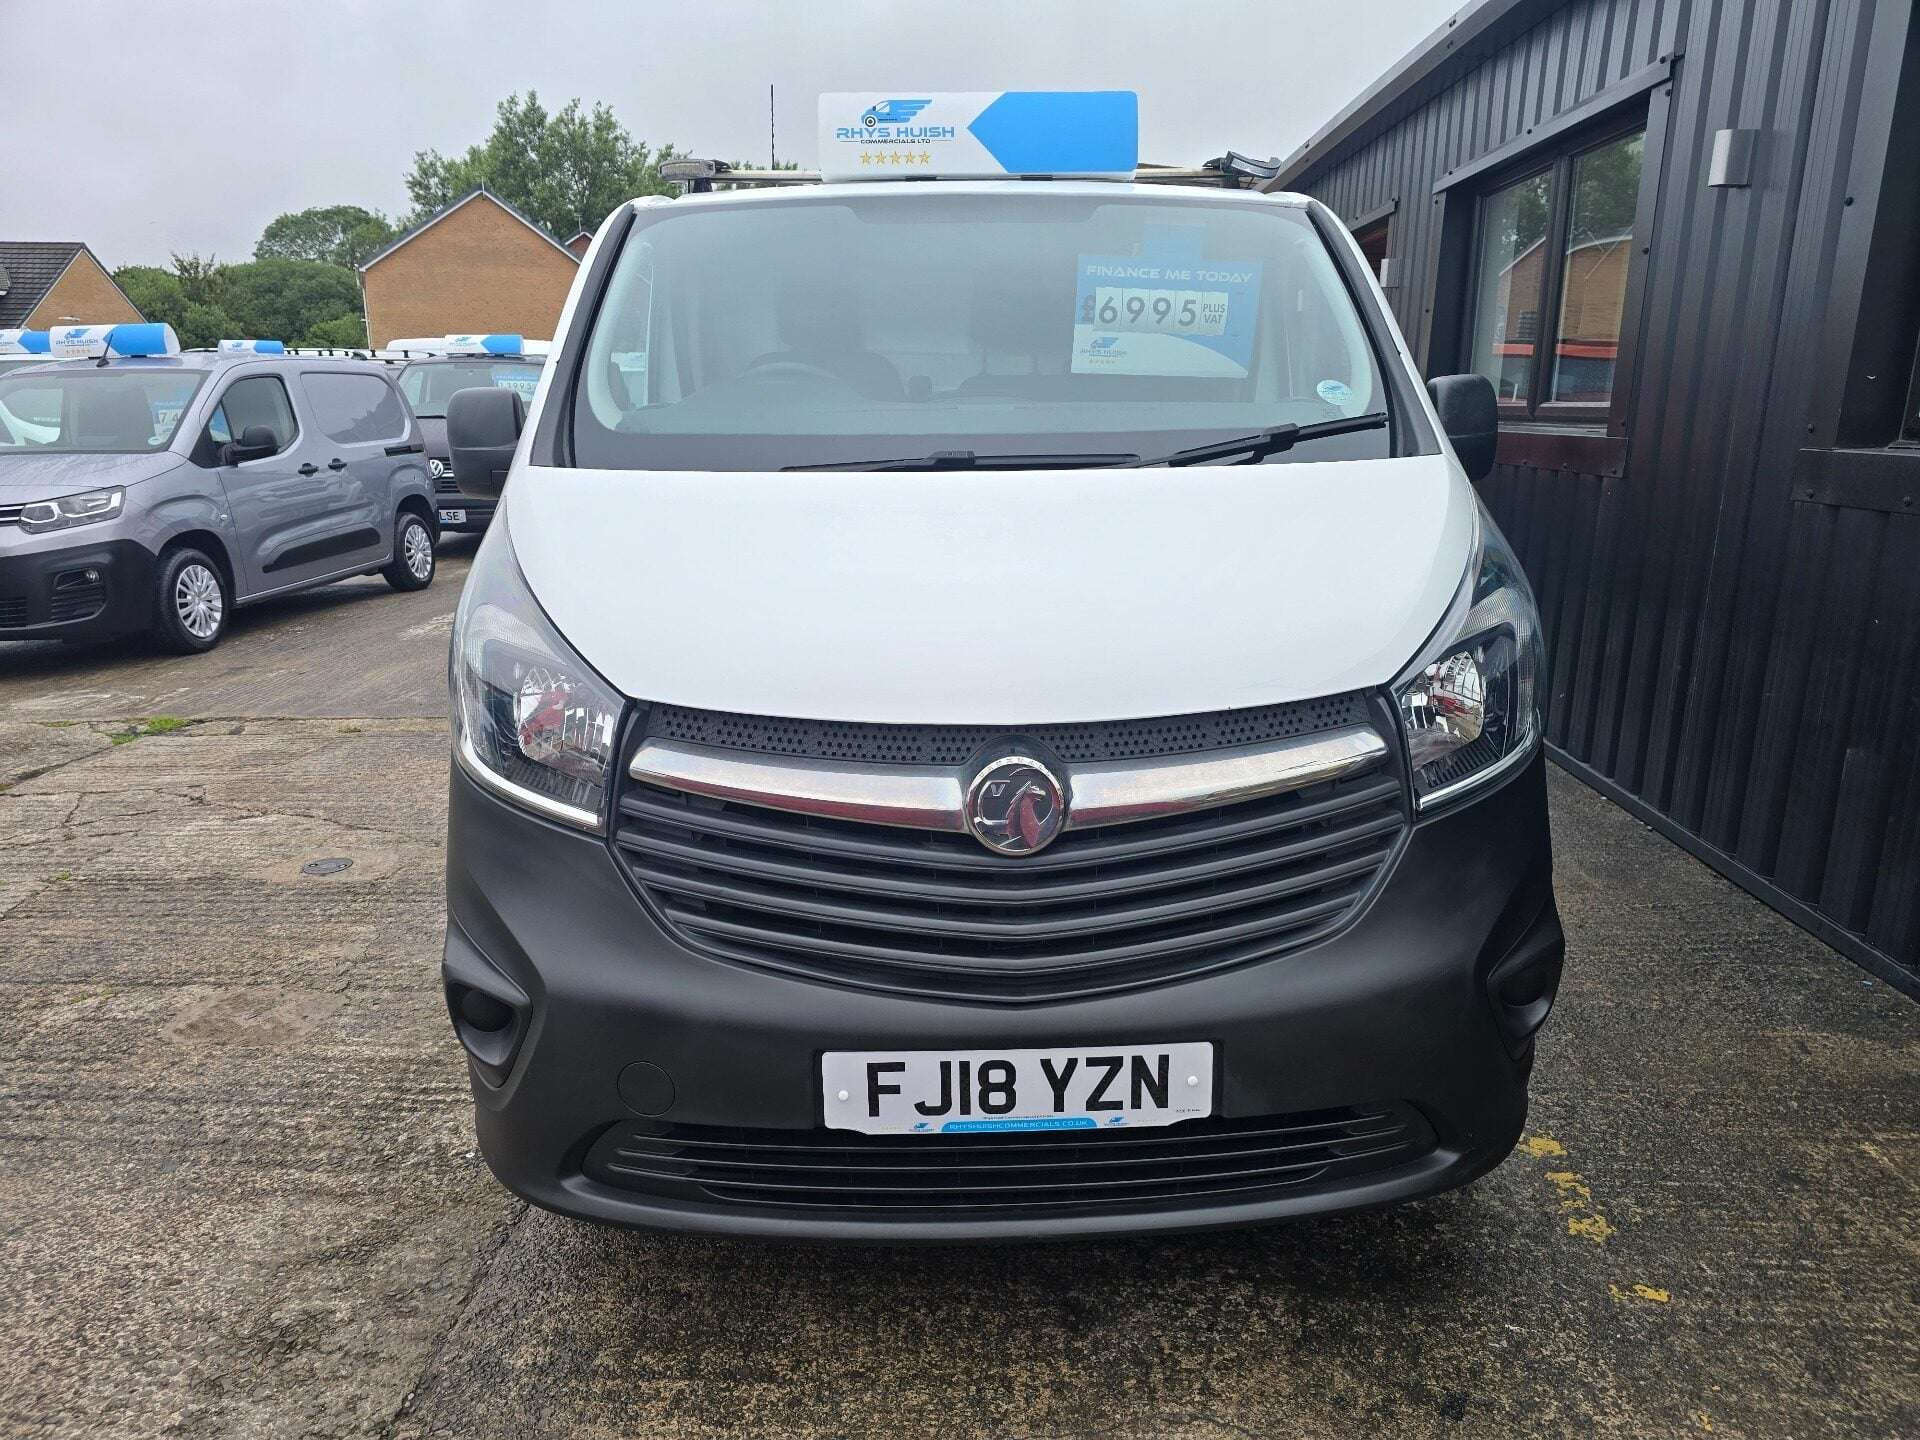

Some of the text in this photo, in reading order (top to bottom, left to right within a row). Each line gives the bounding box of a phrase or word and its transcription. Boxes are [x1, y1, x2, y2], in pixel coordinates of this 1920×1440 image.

[836, 126, 955, 138] RHYS HUISH
[1086, 265, 1253, 284] FINANCE ME TODAY
[1202, 303, 1226, 314] PLUS
[1203, 313, 1223, 325] VAT
[866, 1053, 1170, 1118] FJ18 YZN
